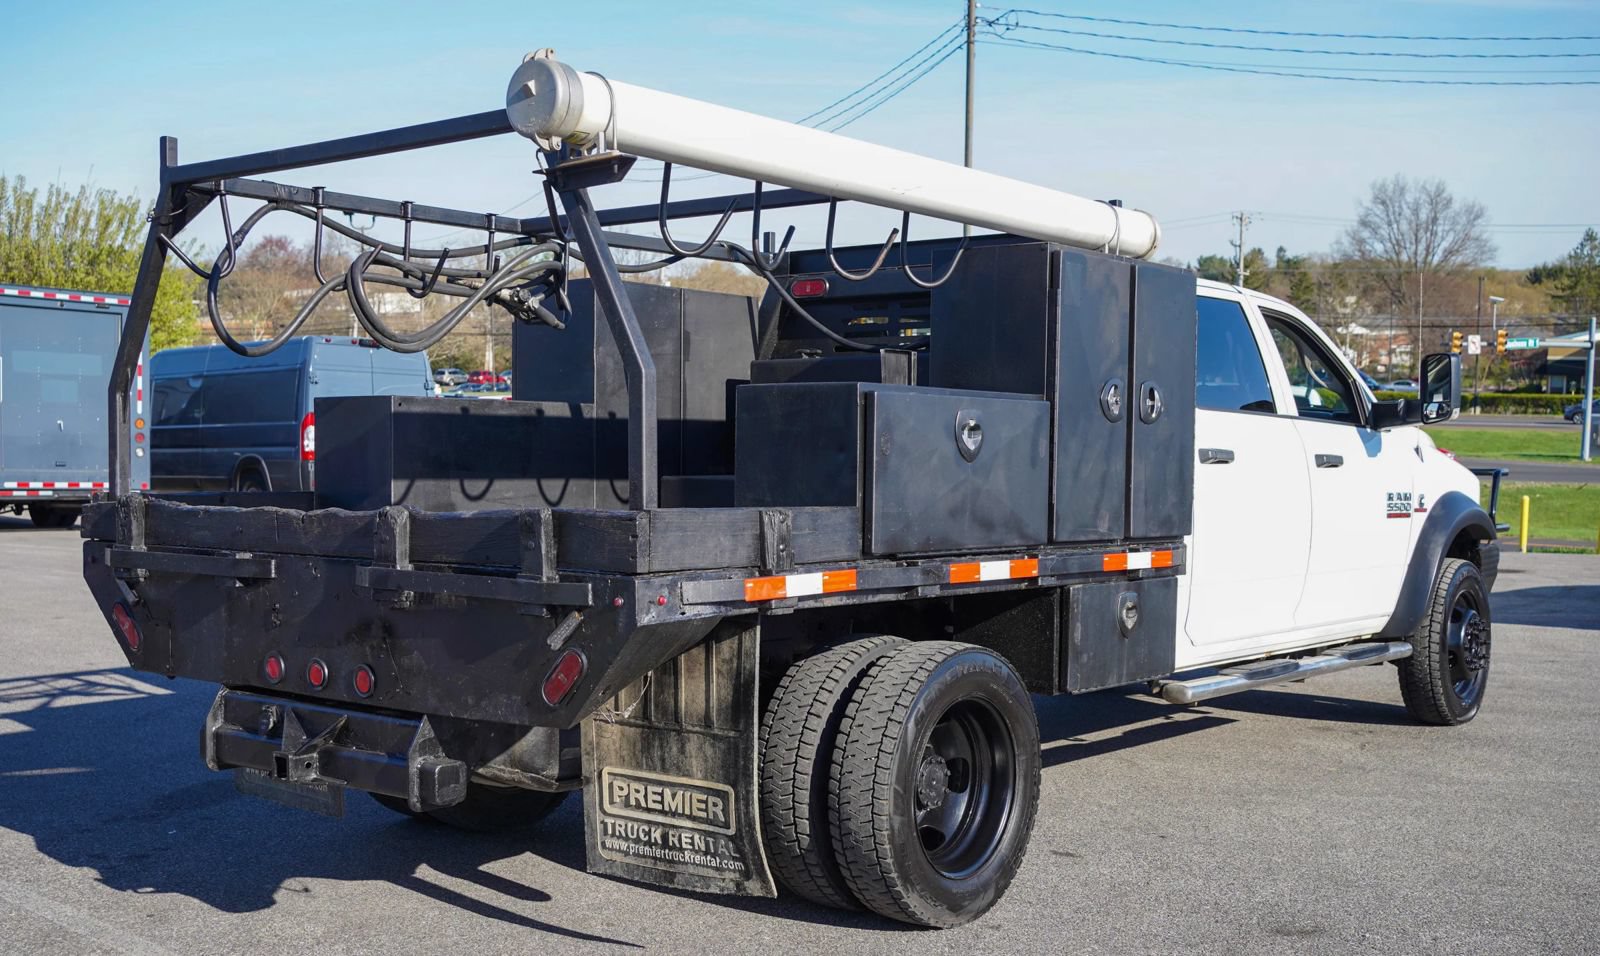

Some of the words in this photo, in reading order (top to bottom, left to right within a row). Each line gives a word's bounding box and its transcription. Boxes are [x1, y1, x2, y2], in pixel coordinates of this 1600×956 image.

[1387, 492, 1411, 501] RAM
[1387, 502, 1411, 511] 5500
[611, 780, 725, 822] PREMIER
[603, 819, 663, 845] TRUCK
[668, 829, 740, 858] RENTAL
[604, 838, 745, 871] www.premiertruckrental.com
